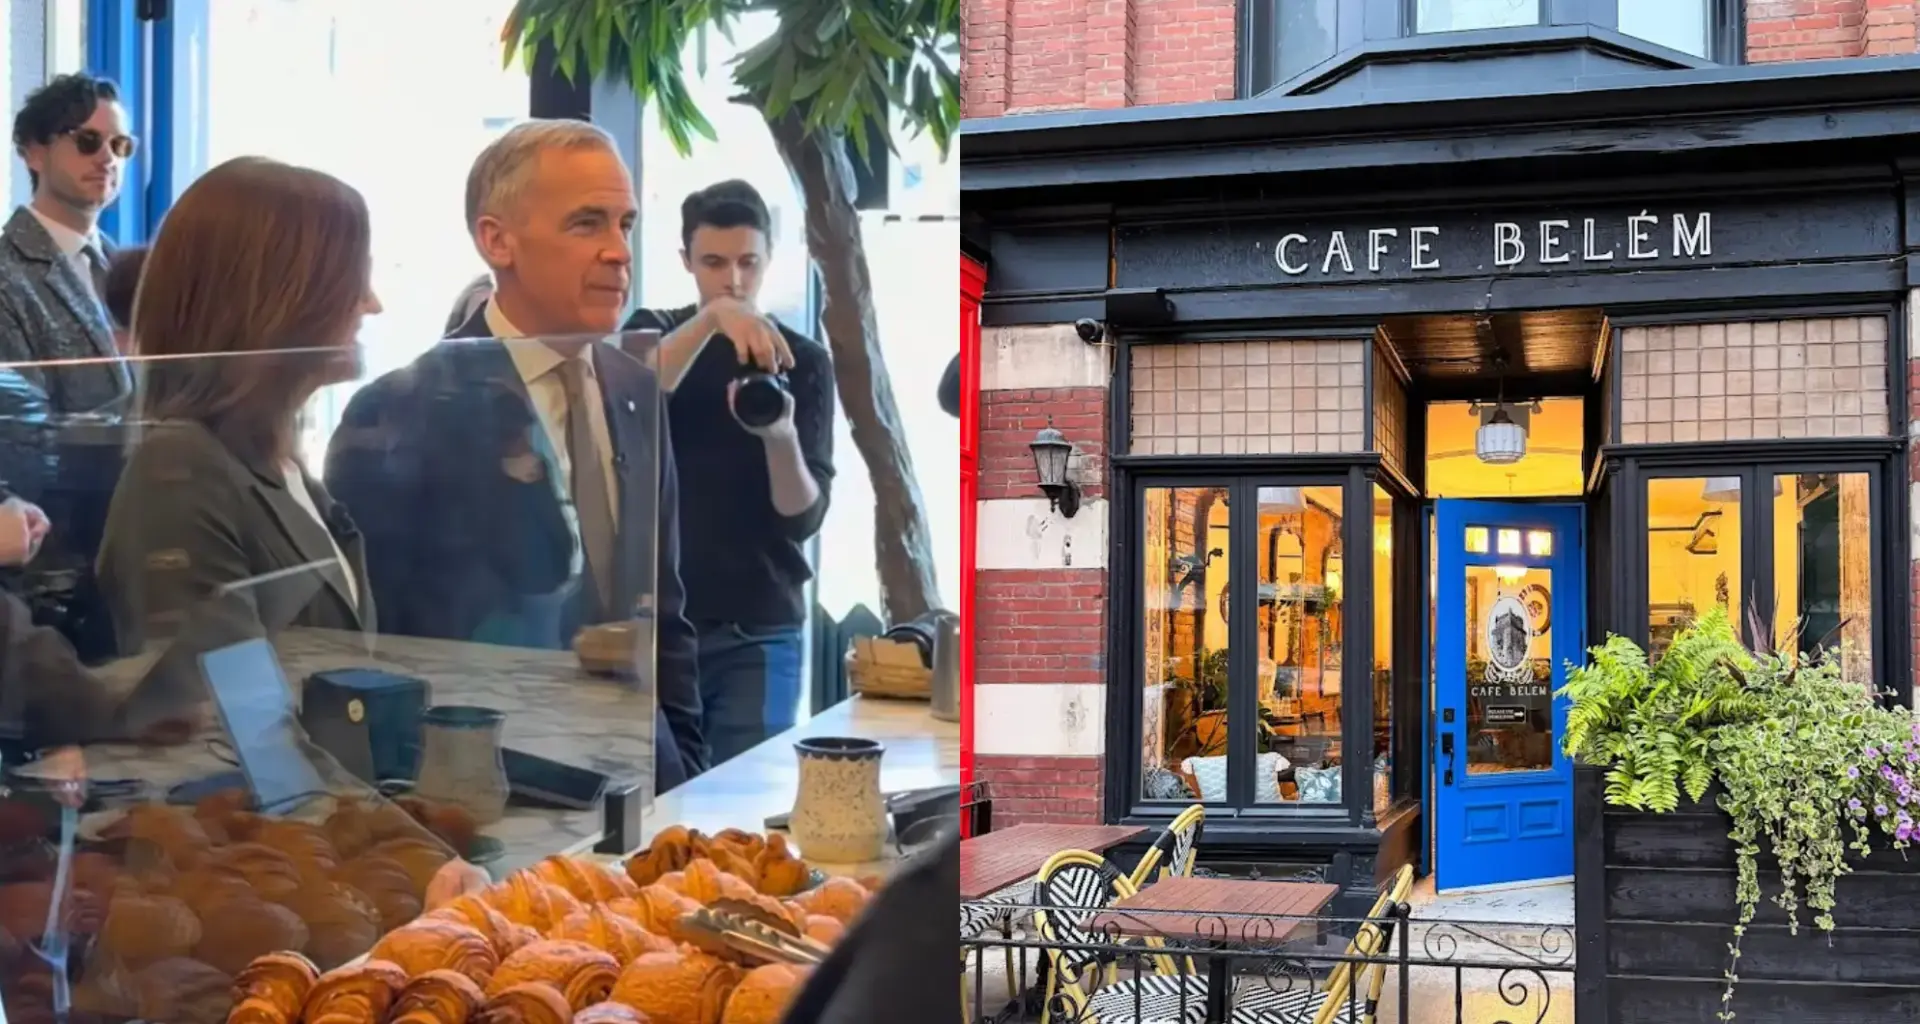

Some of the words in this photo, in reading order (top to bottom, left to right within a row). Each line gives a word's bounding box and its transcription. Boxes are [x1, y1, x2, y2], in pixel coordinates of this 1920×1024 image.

[1275, 226, 1441, 275] CAFE
[1494, 210, 1712, 266] BELÉM
[1471, 686, 1502, 697] CAFE
